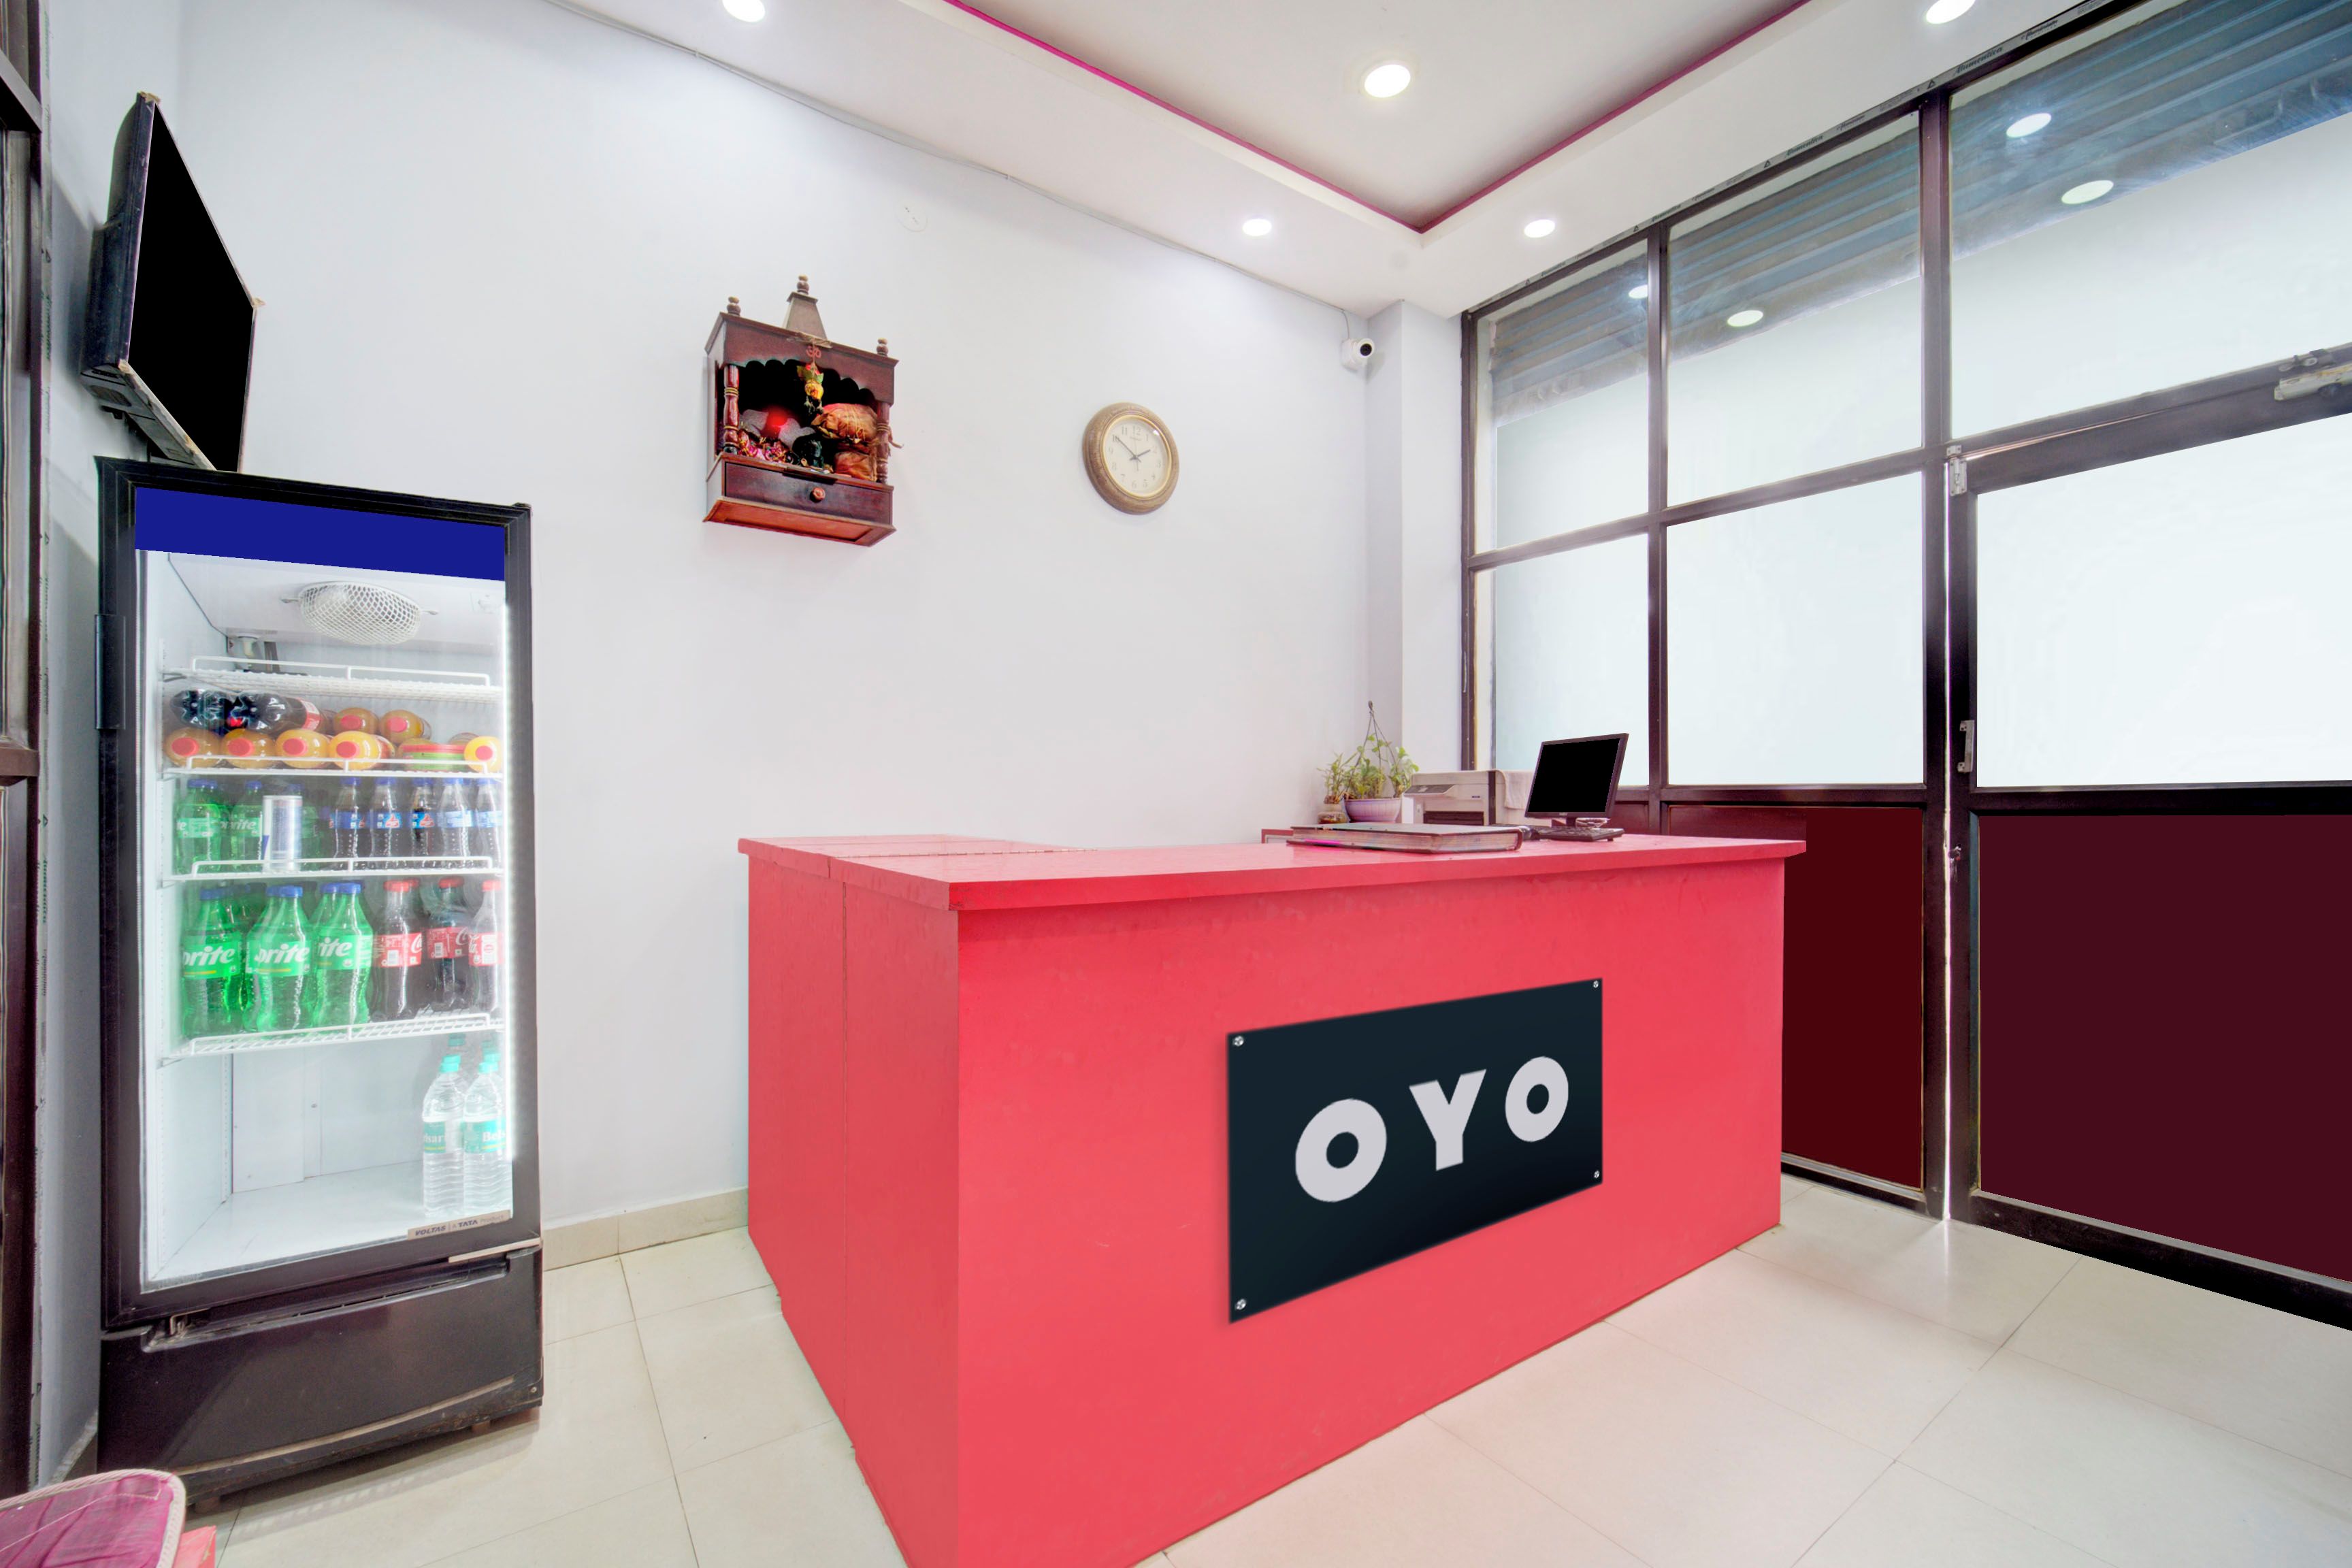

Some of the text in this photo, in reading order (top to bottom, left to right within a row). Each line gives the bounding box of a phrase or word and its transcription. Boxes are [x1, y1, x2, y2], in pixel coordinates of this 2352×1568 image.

[1295, 1056, 1569, 1203] OYO
[415, 1225, 446, 1237] VOLTAS
[457, 1219, 478, 1228] TATA
